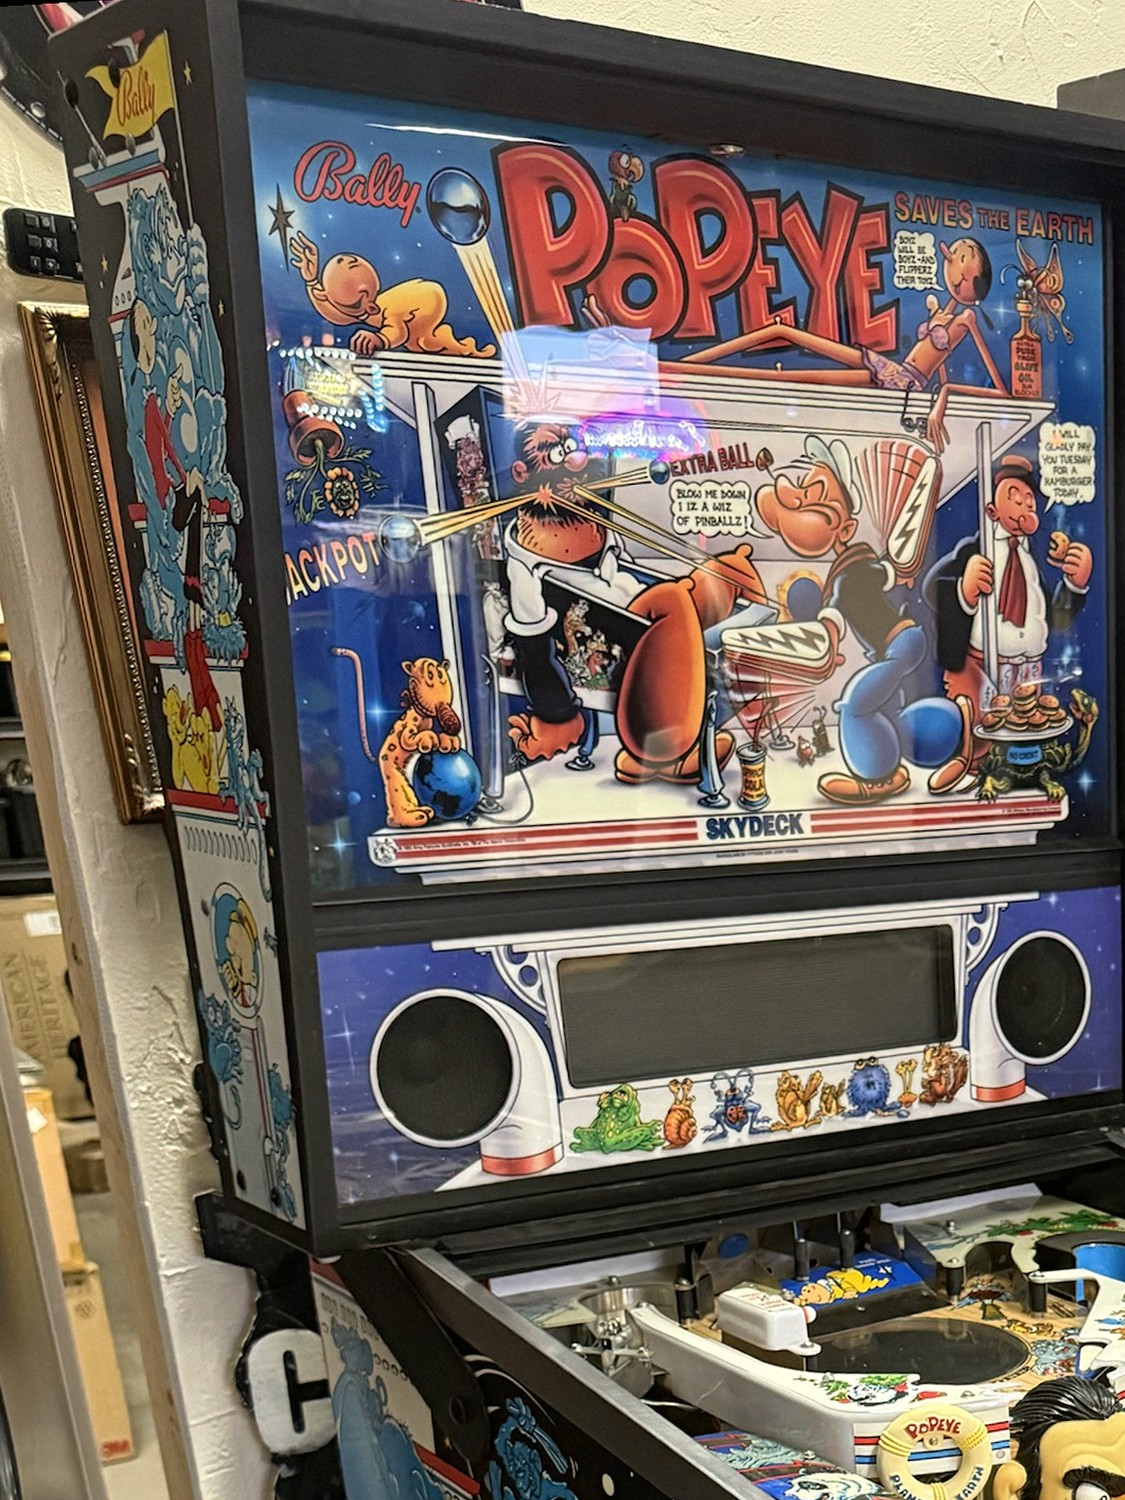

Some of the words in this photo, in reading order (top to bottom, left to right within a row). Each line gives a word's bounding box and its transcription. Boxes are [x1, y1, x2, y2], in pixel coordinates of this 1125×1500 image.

[117, 66, 156, 127] Bally
[293, 140, 422, 228] Bally
[894, 191, 974, 230] SAVES
[977, 208, 1010, 231] THE
[1015, 208, 1094, 245] EARTH
[491, 141, 900, 354] POPEYE
[670, 451, 717, 477] EXTRA
[718, 442, 755, 471] BALL
[676, 488, 701, 499] BLOW
[705, 490, 718, 499] ME
[721, 489, 746, 499] DOWN
[701, 502, 709, 512] A
[712, 502, 732, 512] WIZ
[676, 516, 689, 525] OF
[706, 813, 804, 841] SKYDECK
[904, 1416, 962, 1440] POPEYE
